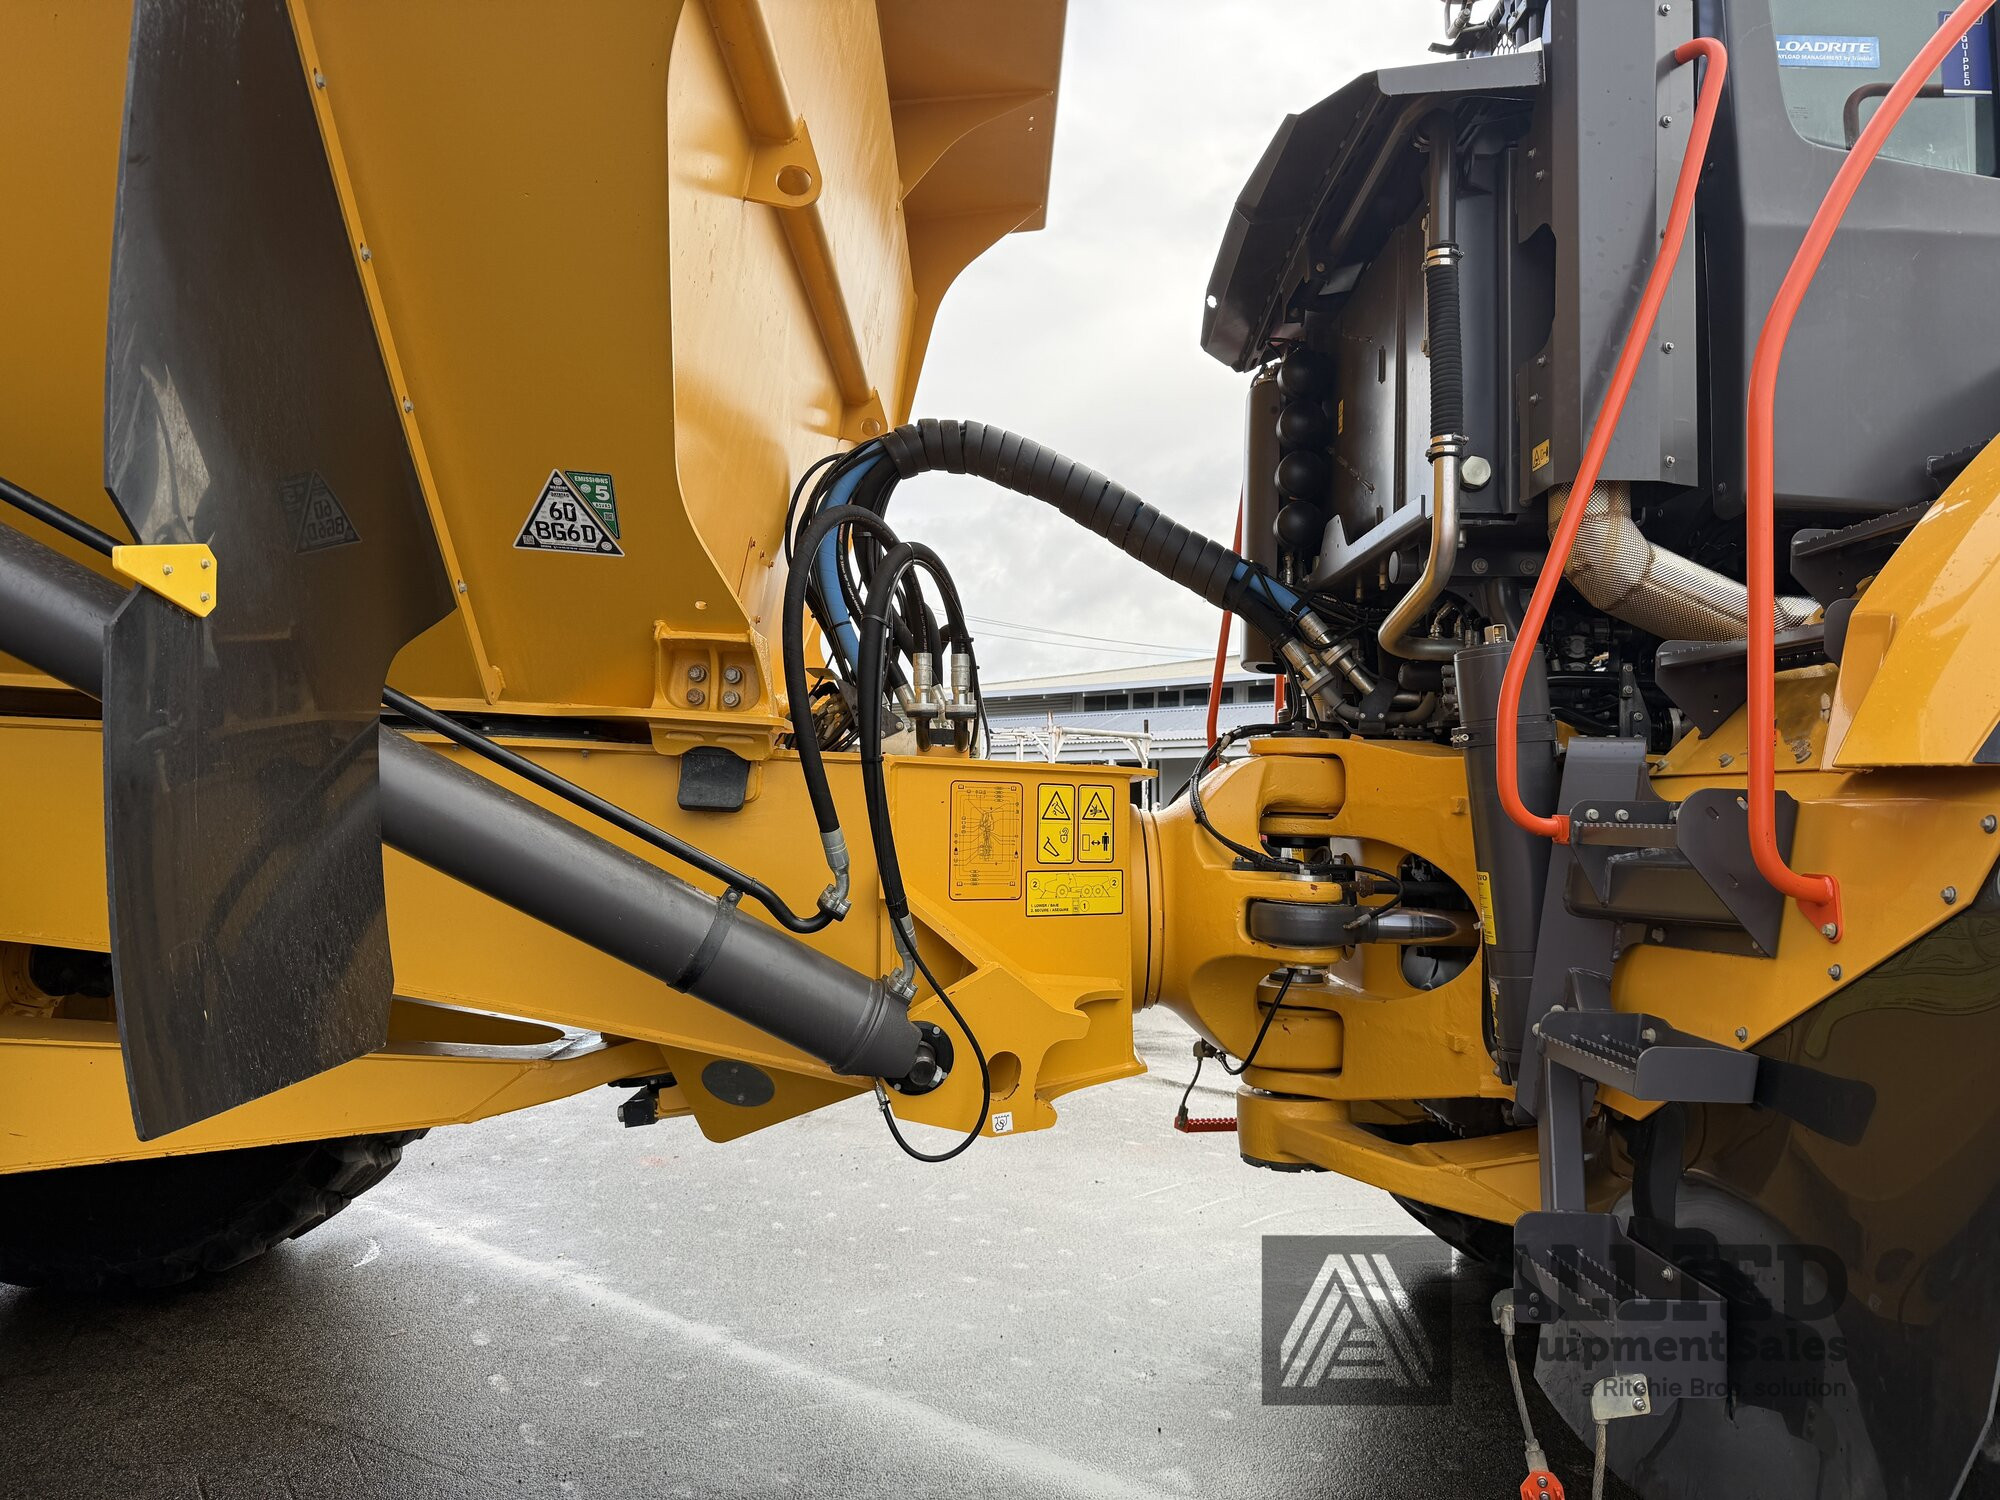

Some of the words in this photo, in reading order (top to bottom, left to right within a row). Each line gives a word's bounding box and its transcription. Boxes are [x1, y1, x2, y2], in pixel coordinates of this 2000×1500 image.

[1776, 40, 1873, 54] LOADRITE
[1961, 32, 1971, 87] QUIPPED
[595, 485, 610, 500] 5
[535, 521, 597, 543] BG6D
